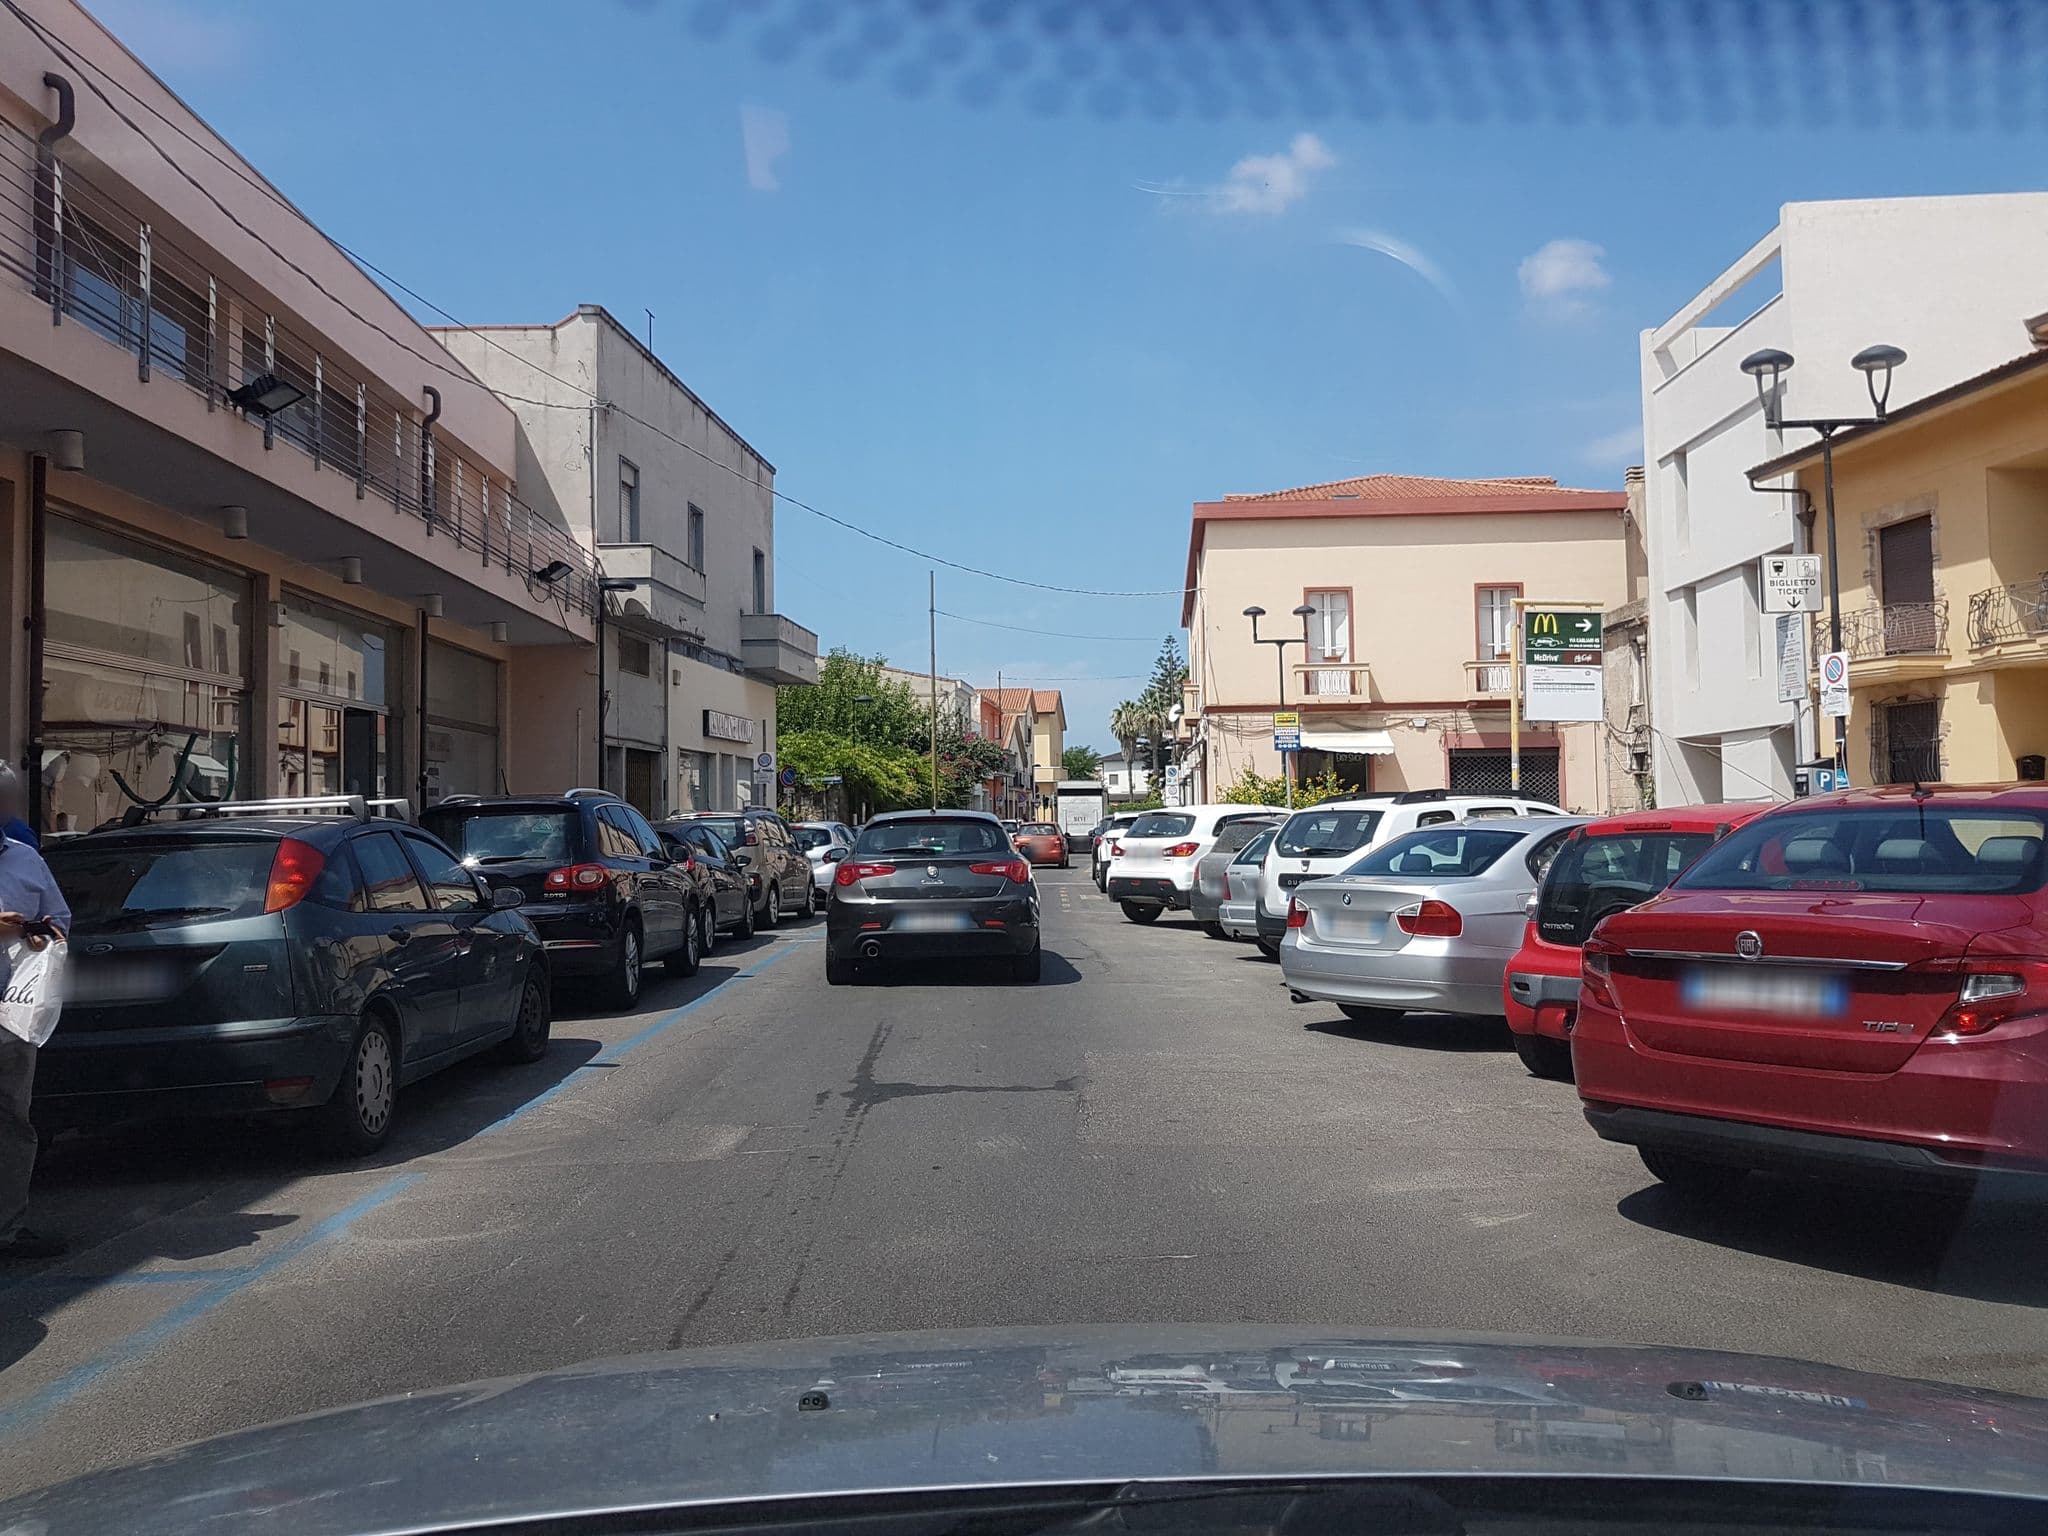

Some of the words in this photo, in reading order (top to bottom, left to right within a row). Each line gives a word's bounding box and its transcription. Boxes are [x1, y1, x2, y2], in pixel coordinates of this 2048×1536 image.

[1769, 579, 1816, 587] BIGLIETTO
[1820, 772, 1830, 788] P
[1739, 938, 1756, 953] FIAT
